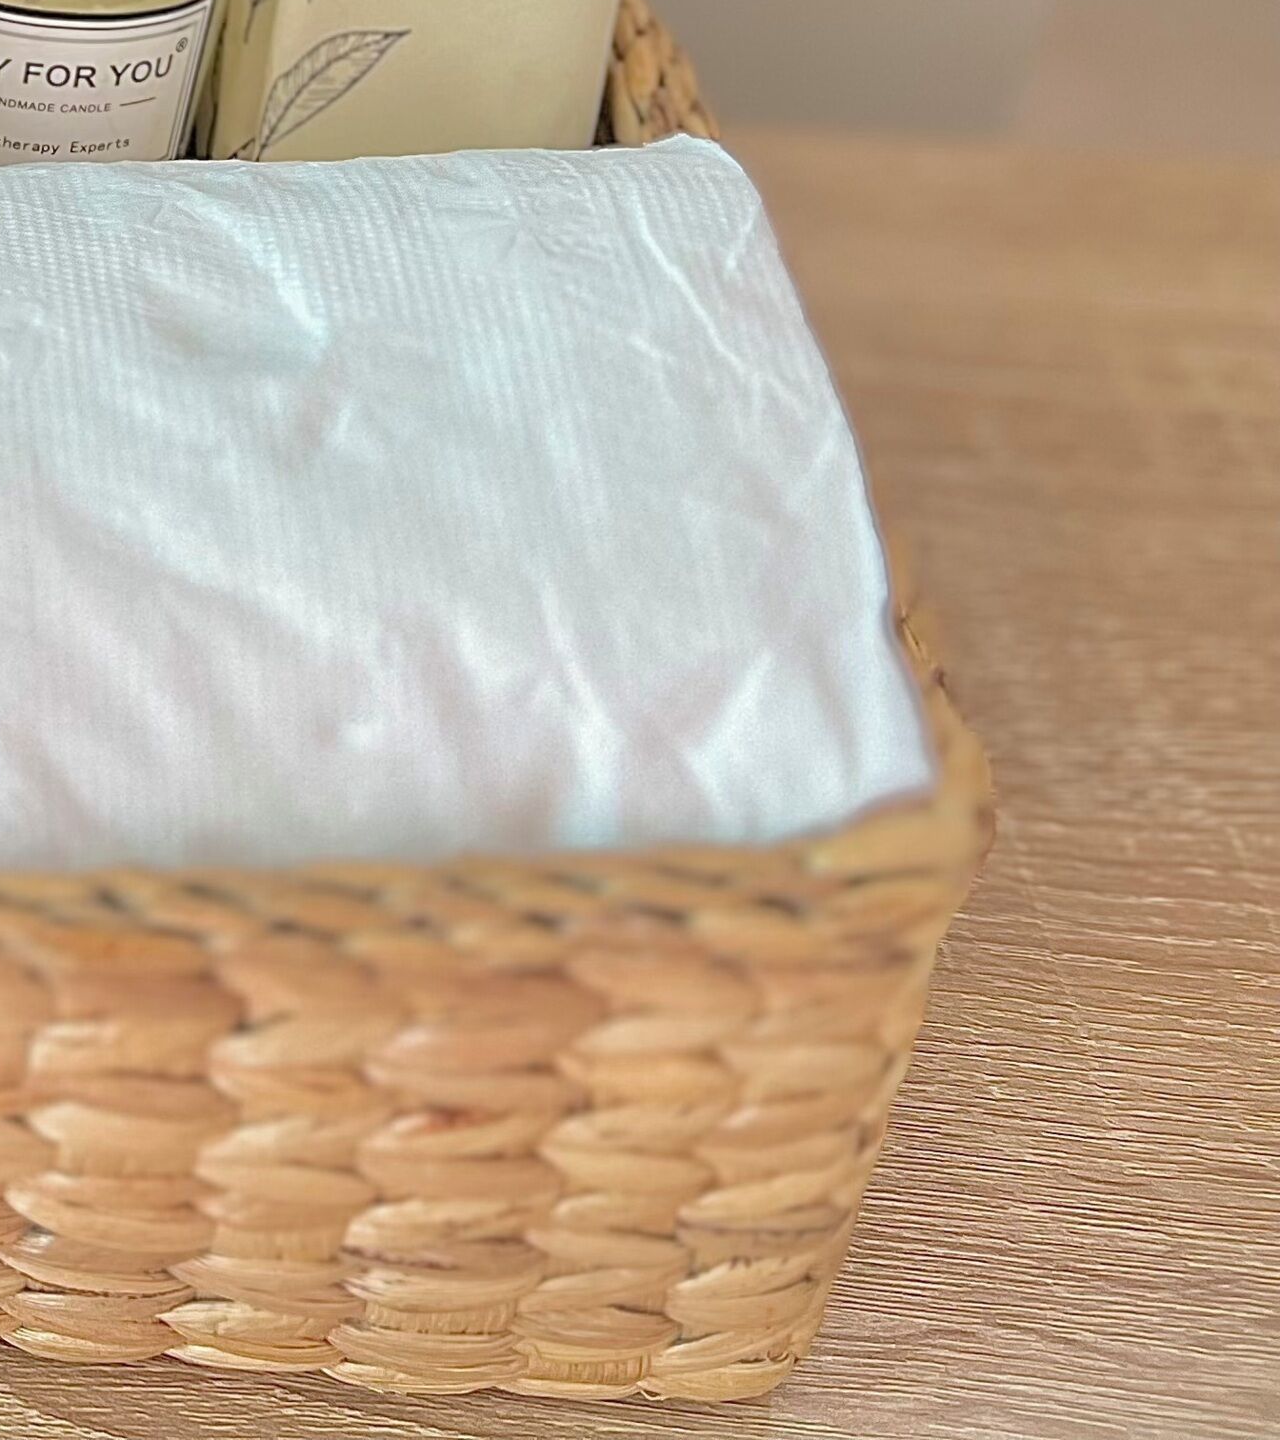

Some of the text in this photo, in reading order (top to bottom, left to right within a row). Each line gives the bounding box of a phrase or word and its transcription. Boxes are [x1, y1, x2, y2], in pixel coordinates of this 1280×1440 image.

[23, 62, 97, 88] FOR
[60, 102, 112, 114] CANDLE
[69, 137, 130, 154] Experts
